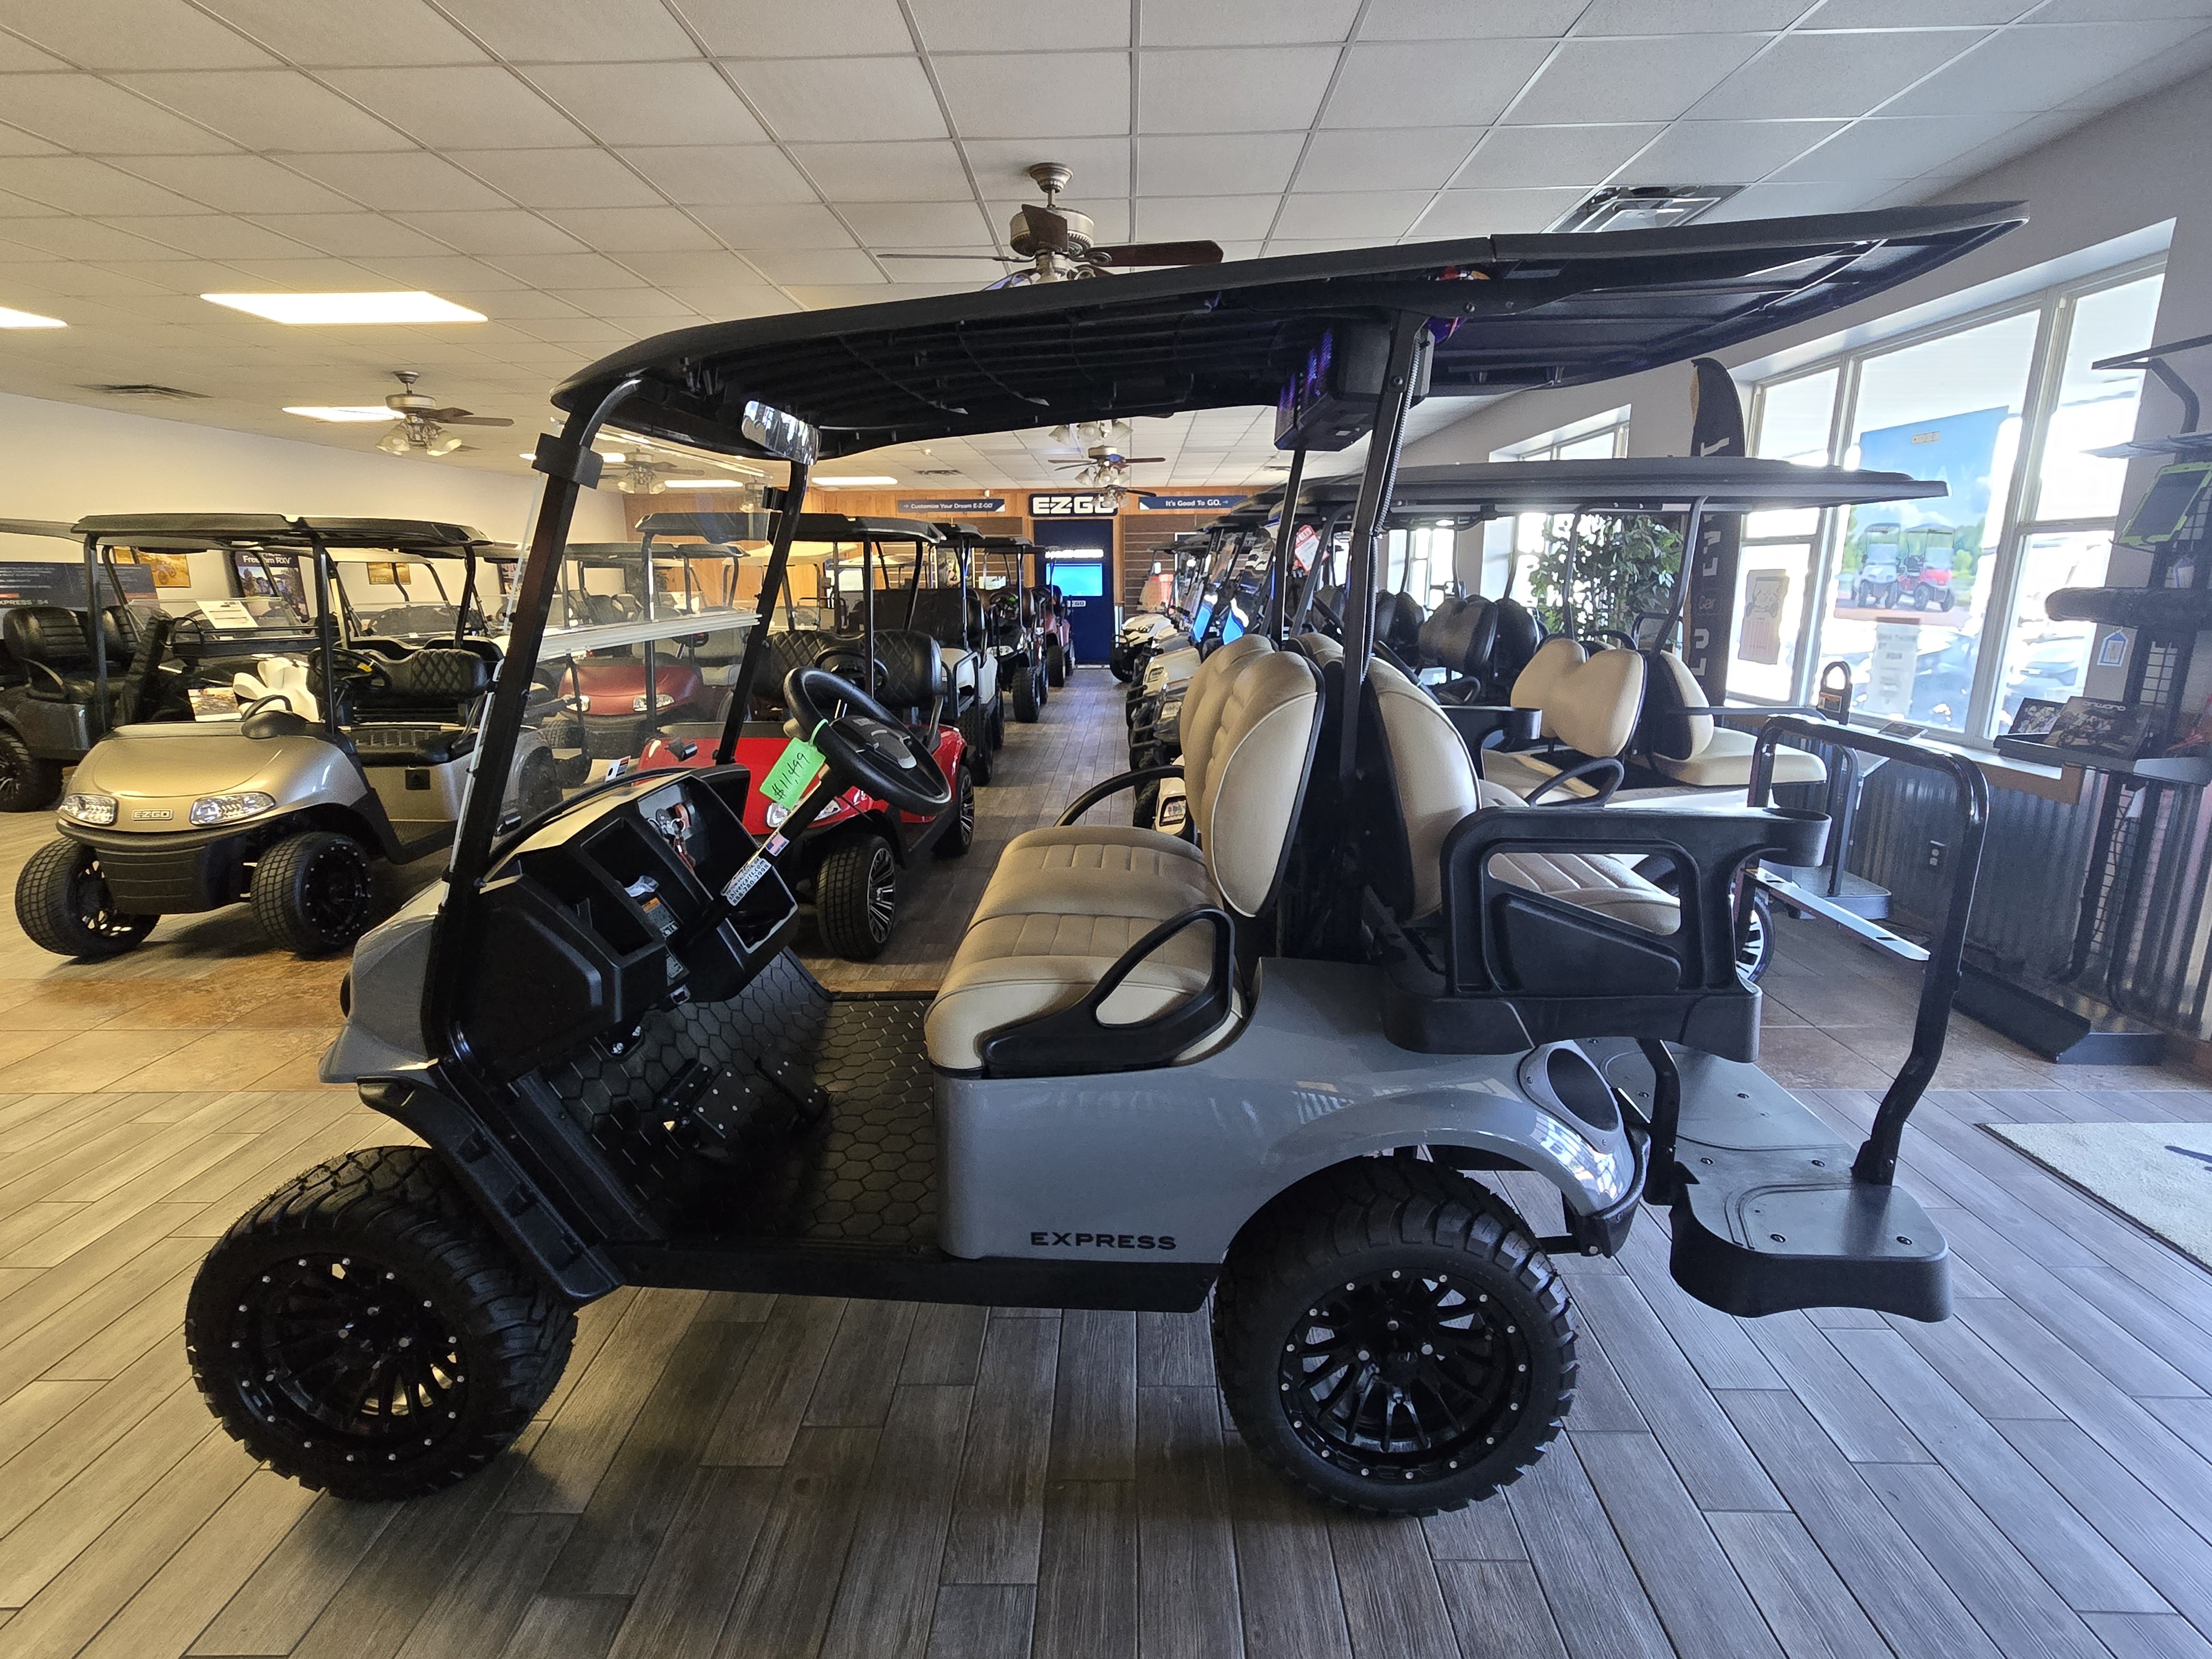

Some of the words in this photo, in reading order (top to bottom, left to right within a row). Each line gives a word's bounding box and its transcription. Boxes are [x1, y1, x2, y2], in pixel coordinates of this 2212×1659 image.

[772, 752, 810, 800] $11,499
[729, 860, 765, 900] shivercarts.com
[1030, 1232, 1177, 1250] EXPRESS
